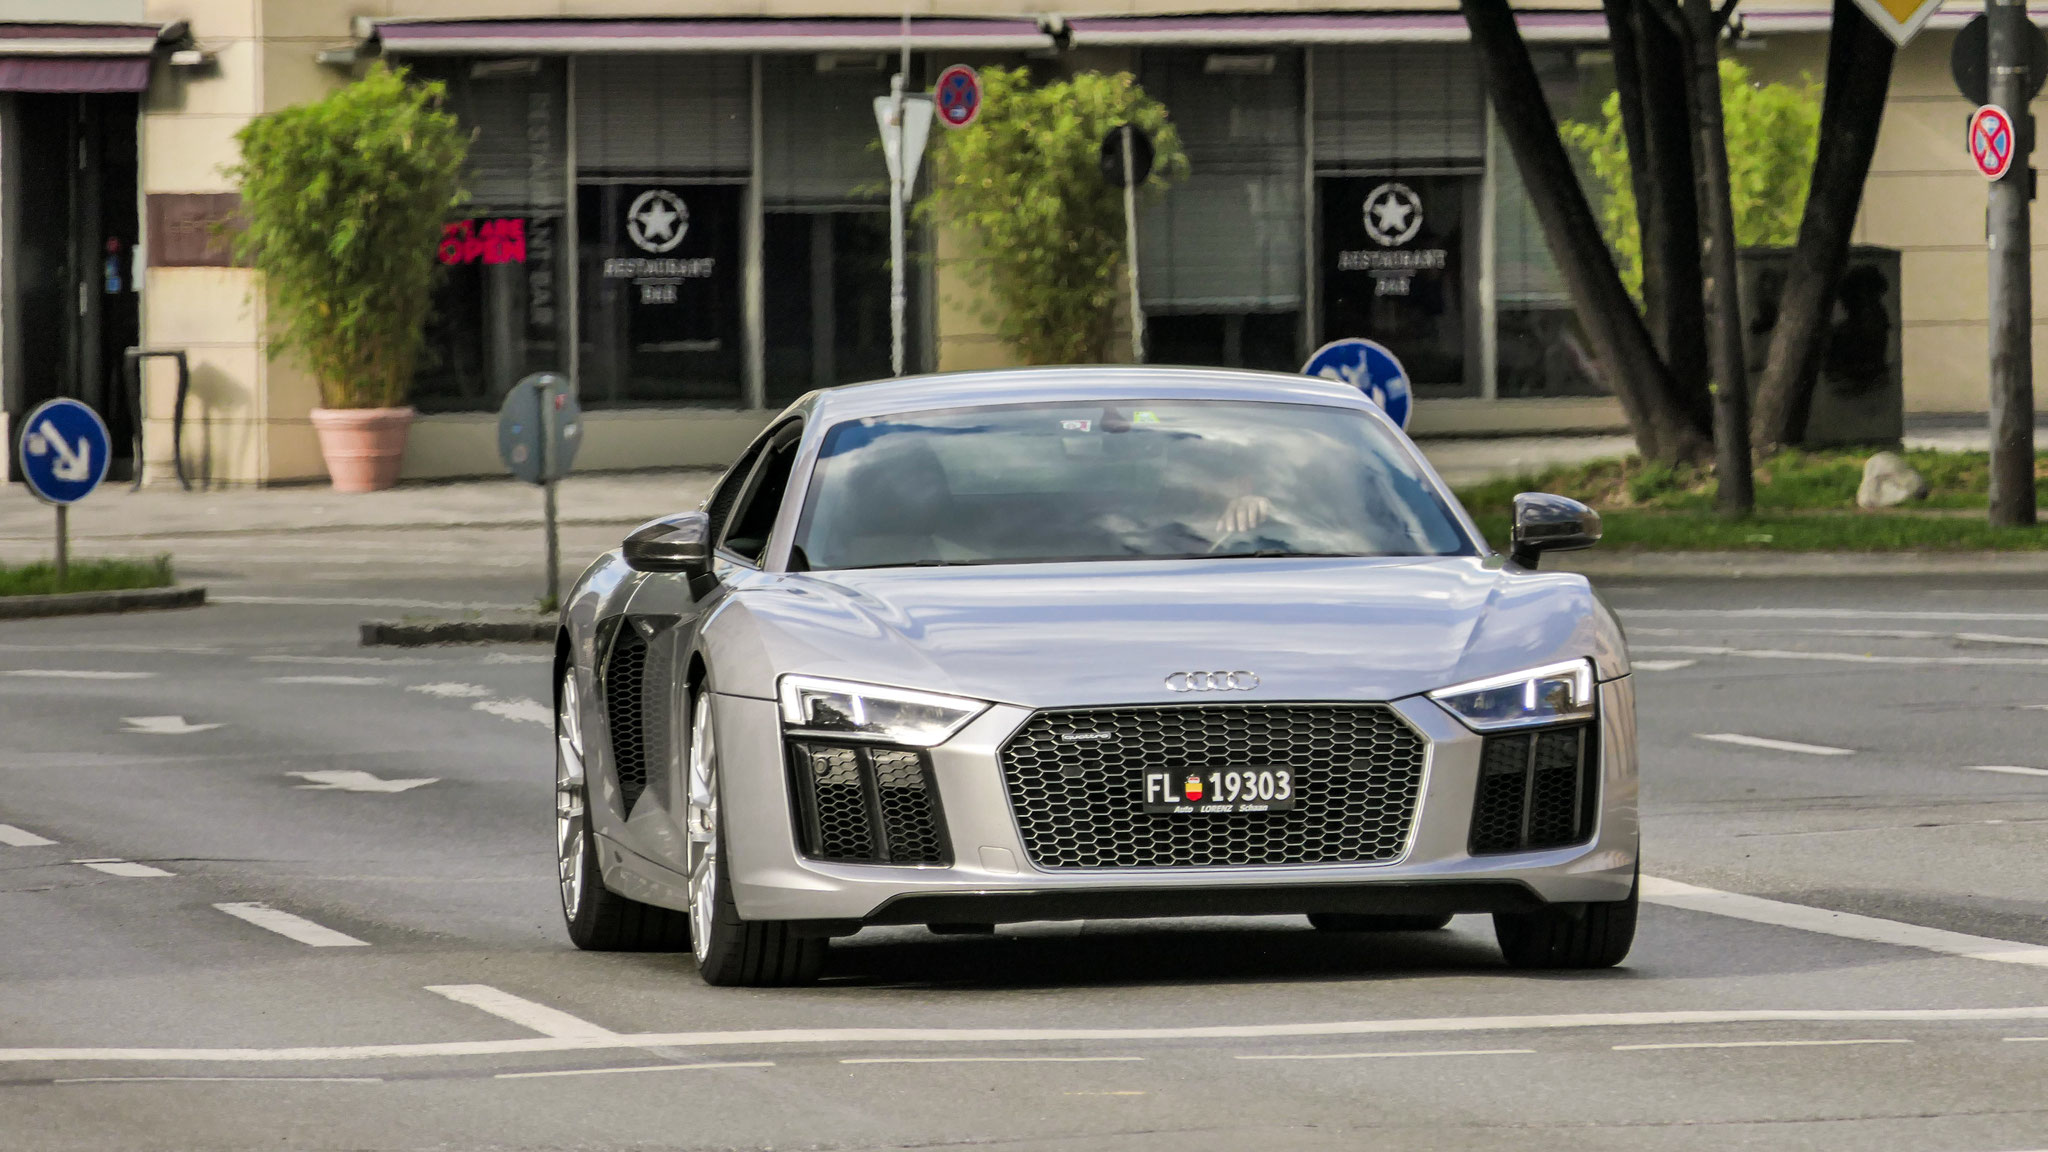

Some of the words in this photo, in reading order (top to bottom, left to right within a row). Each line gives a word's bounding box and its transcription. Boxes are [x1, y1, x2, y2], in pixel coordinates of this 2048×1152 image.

[438, 239, 527, 265] OPEN
[1338, 249, 1447, 271] RESTAURANT
[603, 258, 715, 278] RESTAURANT
[1147, 773, 1180, 803] FL
[1209, 771, 1291, 802] 19303
[1174, 805, 1194, 814] Auto
[1200, 804, 1234, 813] LORENZ
[1238, 803, 1269, 812] Schaan
